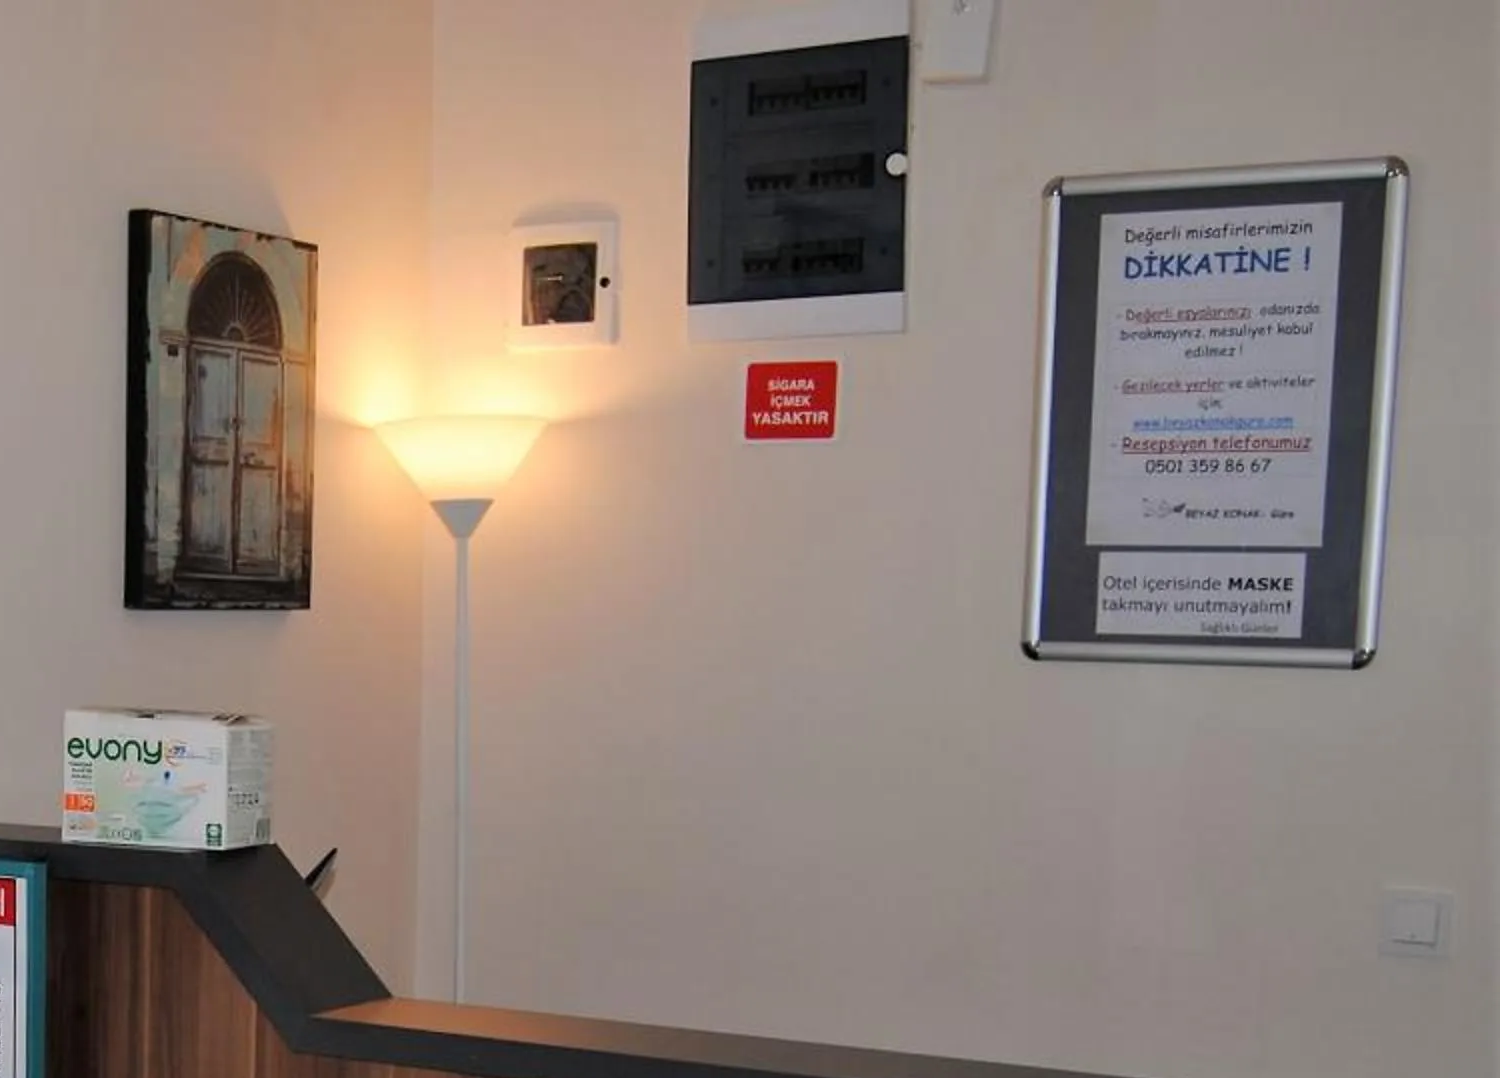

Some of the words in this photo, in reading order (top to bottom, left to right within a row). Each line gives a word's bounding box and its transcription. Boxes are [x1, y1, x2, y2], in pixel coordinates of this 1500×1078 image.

[1125, 226, 1181, 247] Değerli
[1186, 219, 1313, 241] misafirlerimizin
[1124, 245, 1292, 279] DİKKATİNE
[1209, 323, 1271, 340] mesuliyet
[1277, 321, 1314, 336] kabul
[1184, 345, 1236, 359] edilmez
[767, 376, 815, 391] SİGARA
[1228, 380, 1242, 389] ve
[1246, 376, 1316, 389] aktiviteler
[770, 393, 812, 410] İÇMEK
[752, 411, 829, 426] YASAKTIR
[1122, 436, 1207, 455] Resepsiyon
[1213, 435, 1312, 453] telefonumuz
[1145, 459, 1183, 474] 0501
[1188, 459, 1220, 473] 359
[1224, 459, 1245, 473] 86
[1250, 458, 1272, 473] 67
[1103, 575, 1137, 591] Otel
[1143, 575, 1222, 593] içerisinde
[1228, 577, 1294, 592] MASKE
[1102, 599, 1168, 616] takmayı
[67, 737, 163, 765] evony
